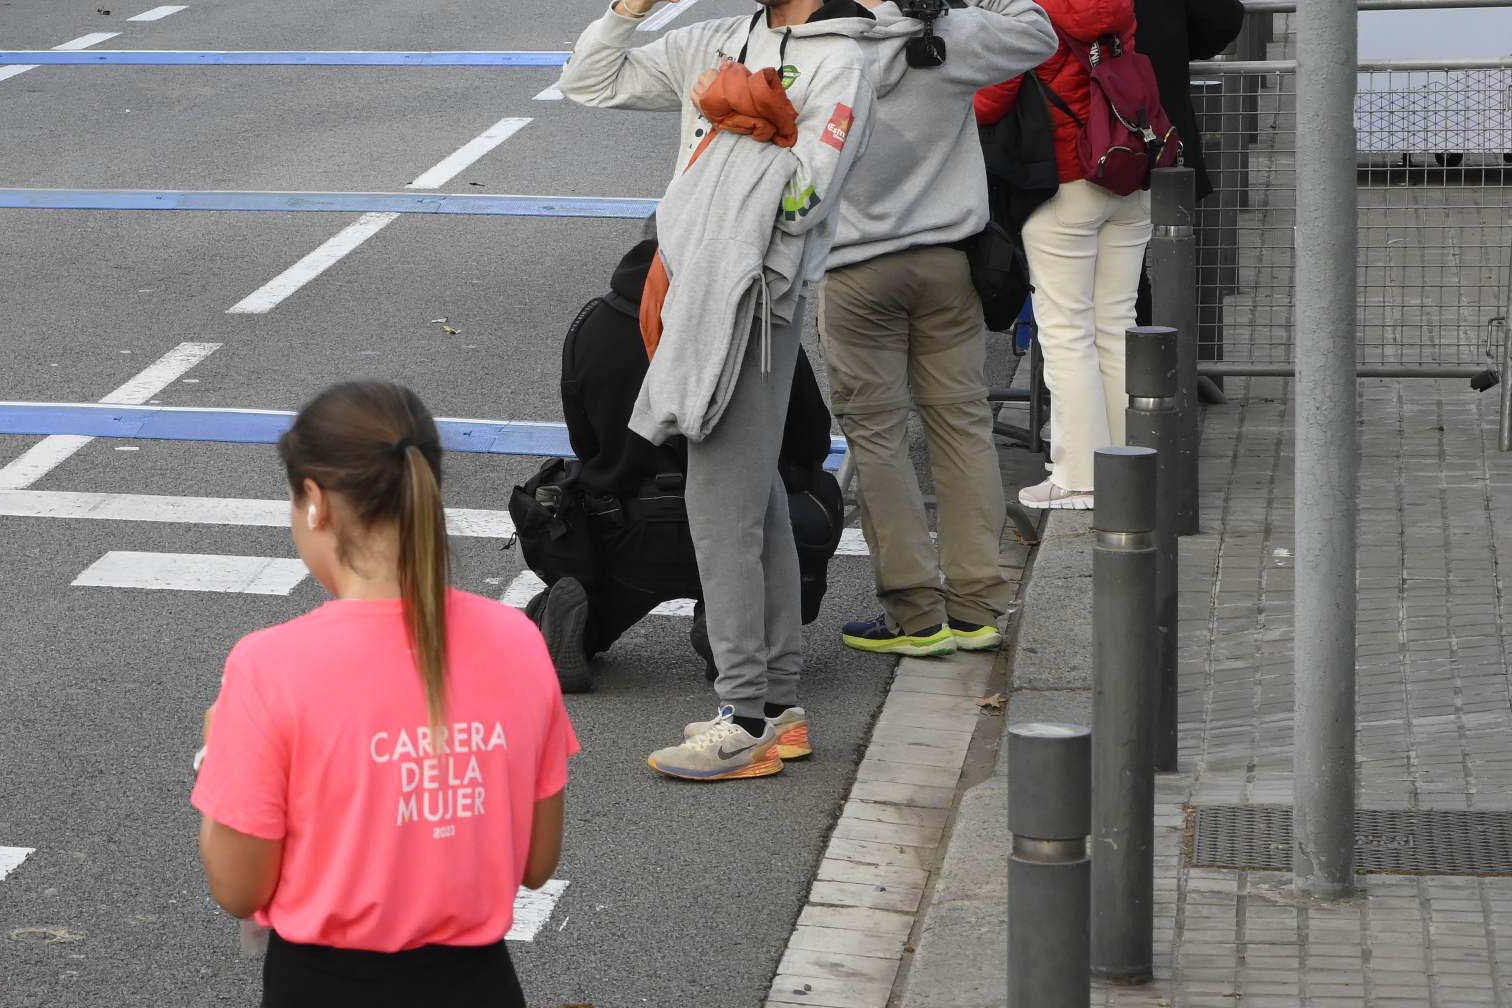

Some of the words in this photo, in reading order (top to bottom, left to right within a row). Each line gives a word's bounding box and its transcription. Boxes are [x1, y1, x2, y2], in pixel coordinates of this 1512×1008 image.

[370, 721, 508, 763] CARRERA
[400, 758, 439, 792] DE
[448, 755, 483, 786] LA
[397, 787, 485, 826] MUJER
